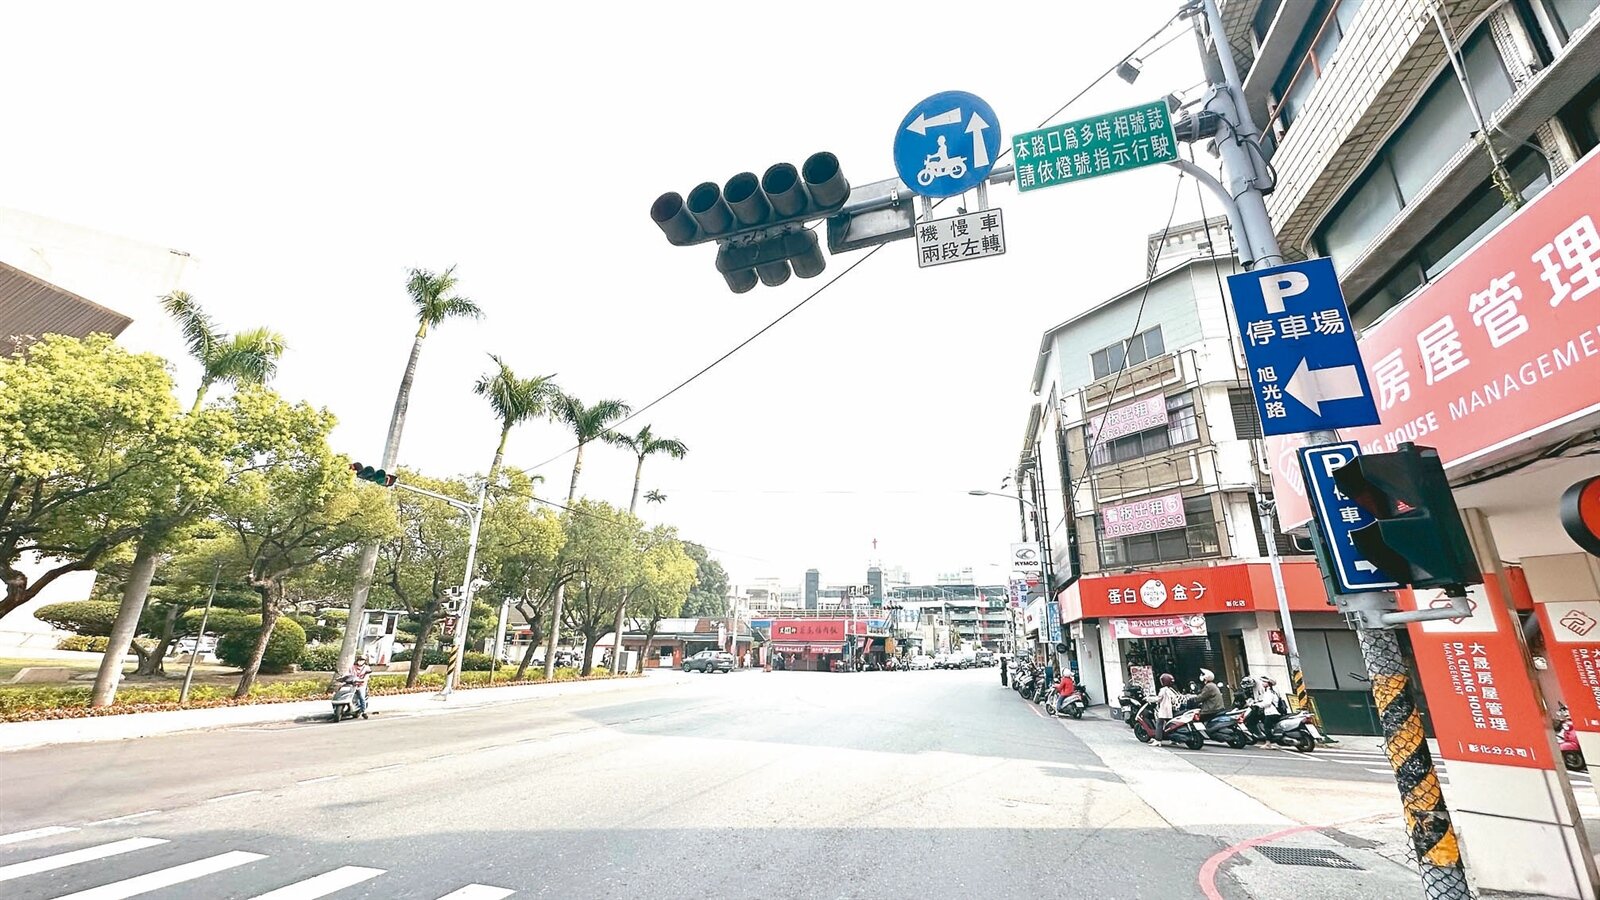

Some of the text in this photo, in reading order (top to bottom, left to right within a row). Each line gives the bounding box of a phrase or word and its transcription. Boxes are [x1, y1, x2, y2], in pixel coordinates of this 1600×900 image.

[1019, 135, 1172, 186] 請依燈號指示行駛
[920, 213, 999, 242] 機慢車
[922, 234, 1001, 263] 兩段左轉
[1259, 271, 1309, 314] P
[1372, 214, 1600, 411] 房屋管理
[1246, 308, 1345, 347] 停車場
[1257, 366, 1287, 418] 旭光路
[1384, 410, 1440, 451] HOUSE
[1449, 325, 1600, 421] MANAGEME
[1096, 413, 1167, 441] 963-281353
[1322, 453, 1347, 478] P
[1106, 514, 1184, 537] 0963-281353
[1107, 581, 1207, 604] 蛋白 盒子
[1442, 643, 1464, 695] MANAGEMENT
[1453, 642, 1487, 729] DA CHANG HOUSE
